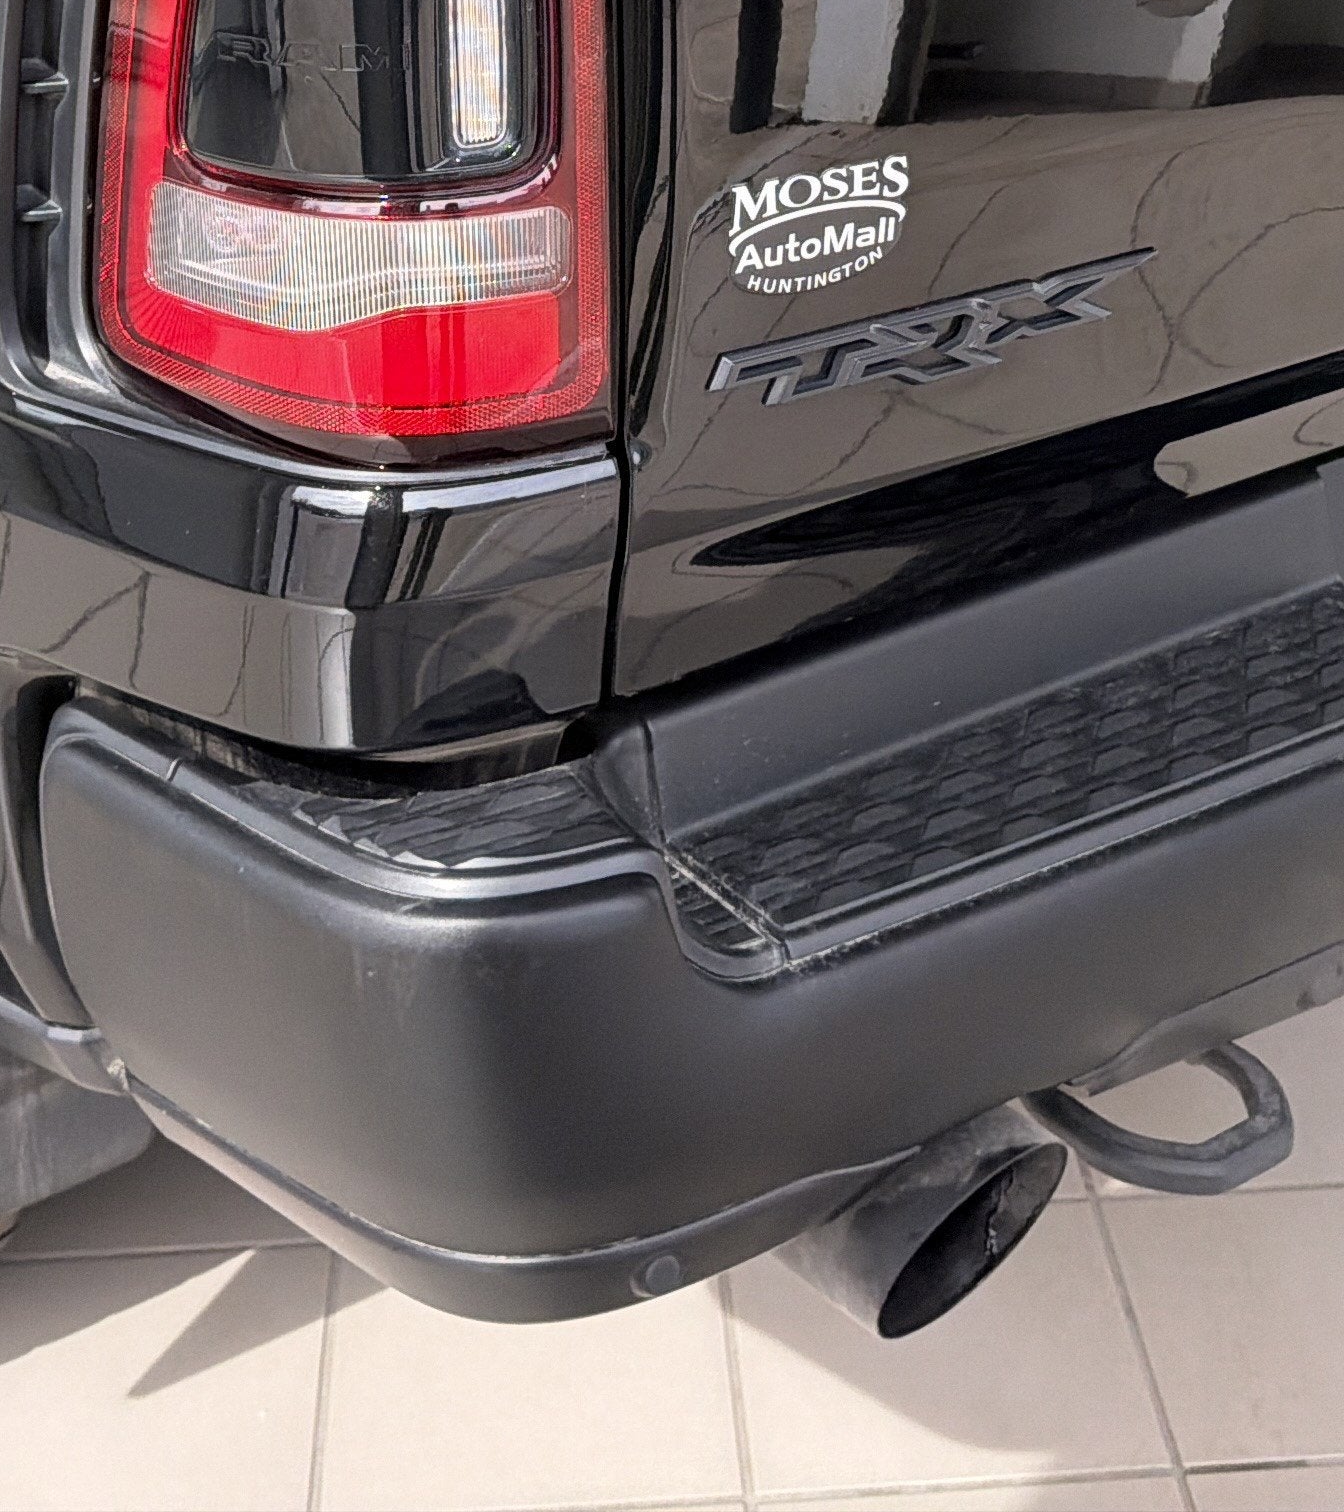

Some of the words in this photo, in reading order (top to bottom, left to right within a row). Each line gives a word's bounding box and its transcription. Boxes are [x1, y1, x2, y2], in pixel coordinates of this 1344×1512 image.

[213, 31, 412, 73] RAM
[728, 155, 909, 238] MOSES
[735, 216, 896, 275] AutoMall
[746, 246, 883, 295] HUNTINGTON
[705, 246, 1159, 407] TRX
